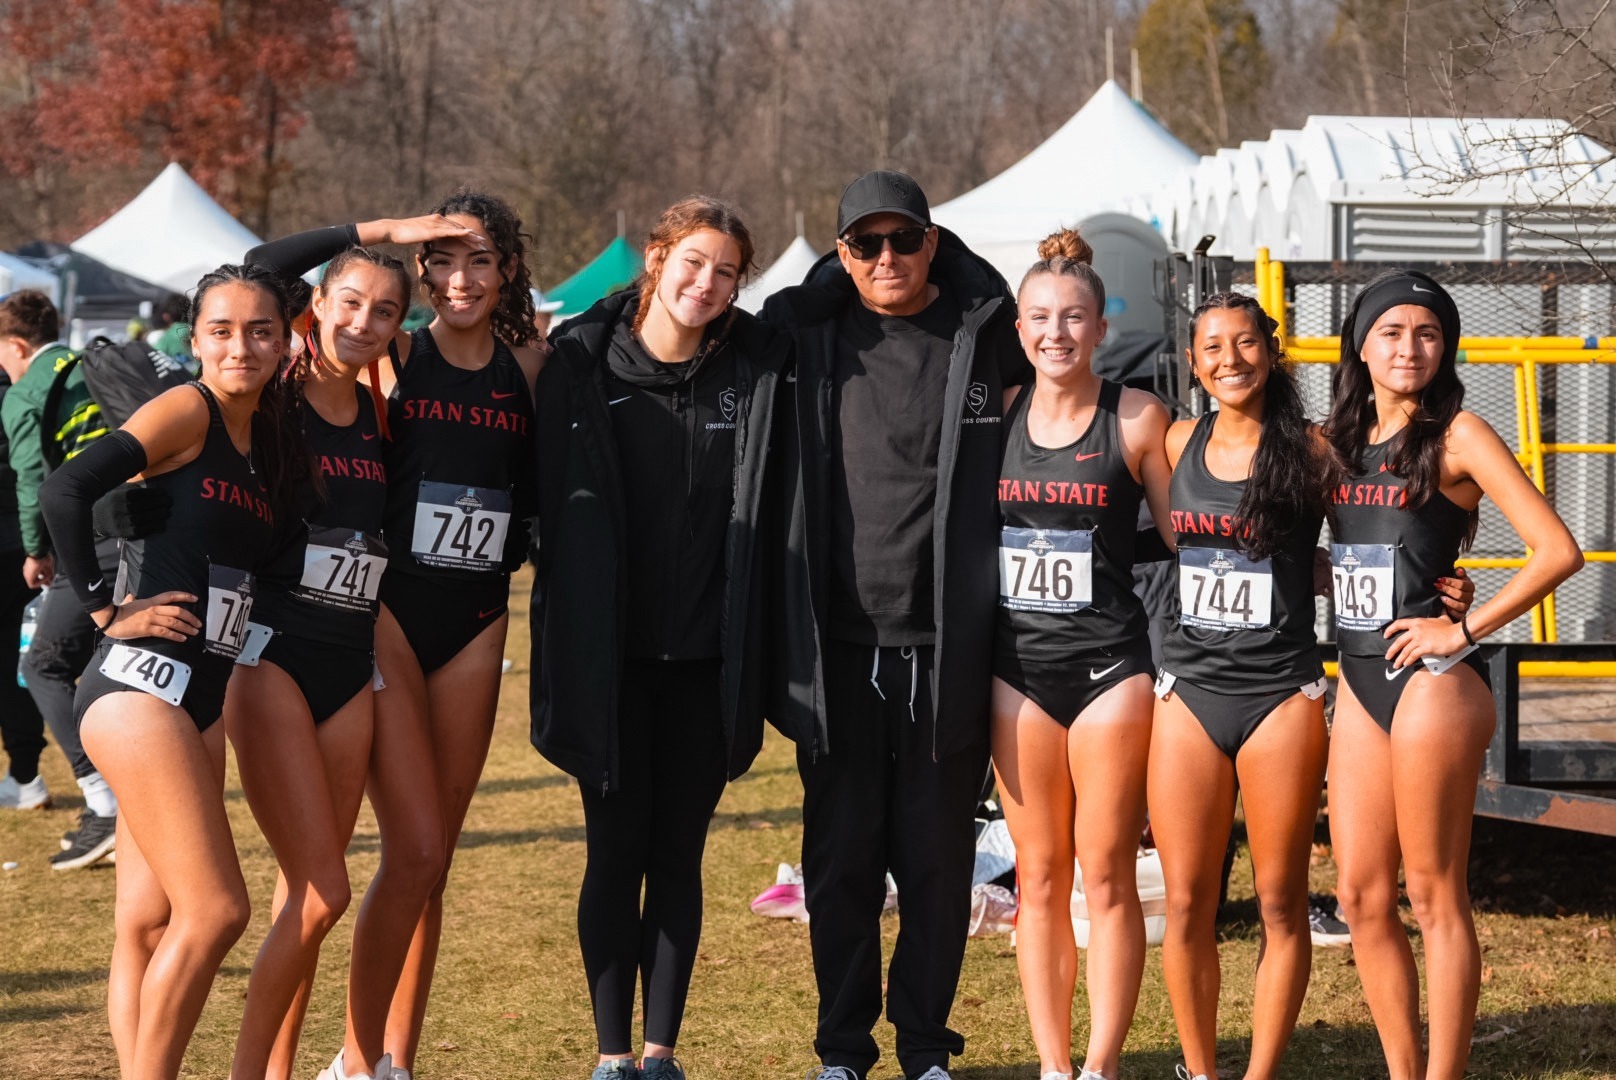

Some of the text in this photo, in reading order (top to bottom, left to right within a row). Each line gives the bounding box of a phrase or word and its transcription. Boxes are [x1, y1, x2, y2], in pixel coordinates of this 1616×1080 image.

[403, 400, 527, 436] STAN STATE
[705, 422, 725, 430] CROSS
[317, 455, 349, 477] AN
[201, 477, 253, 512] STAN
[1045, 481, 1107, 507] STATE
[431, 511, 495, 560] 742
[324, 554, 371, 598] 741
[1011, 555, 1073, 601] 746
[1192, 574, 1253, 622] 744
[121, 648, 175, 690] 740
